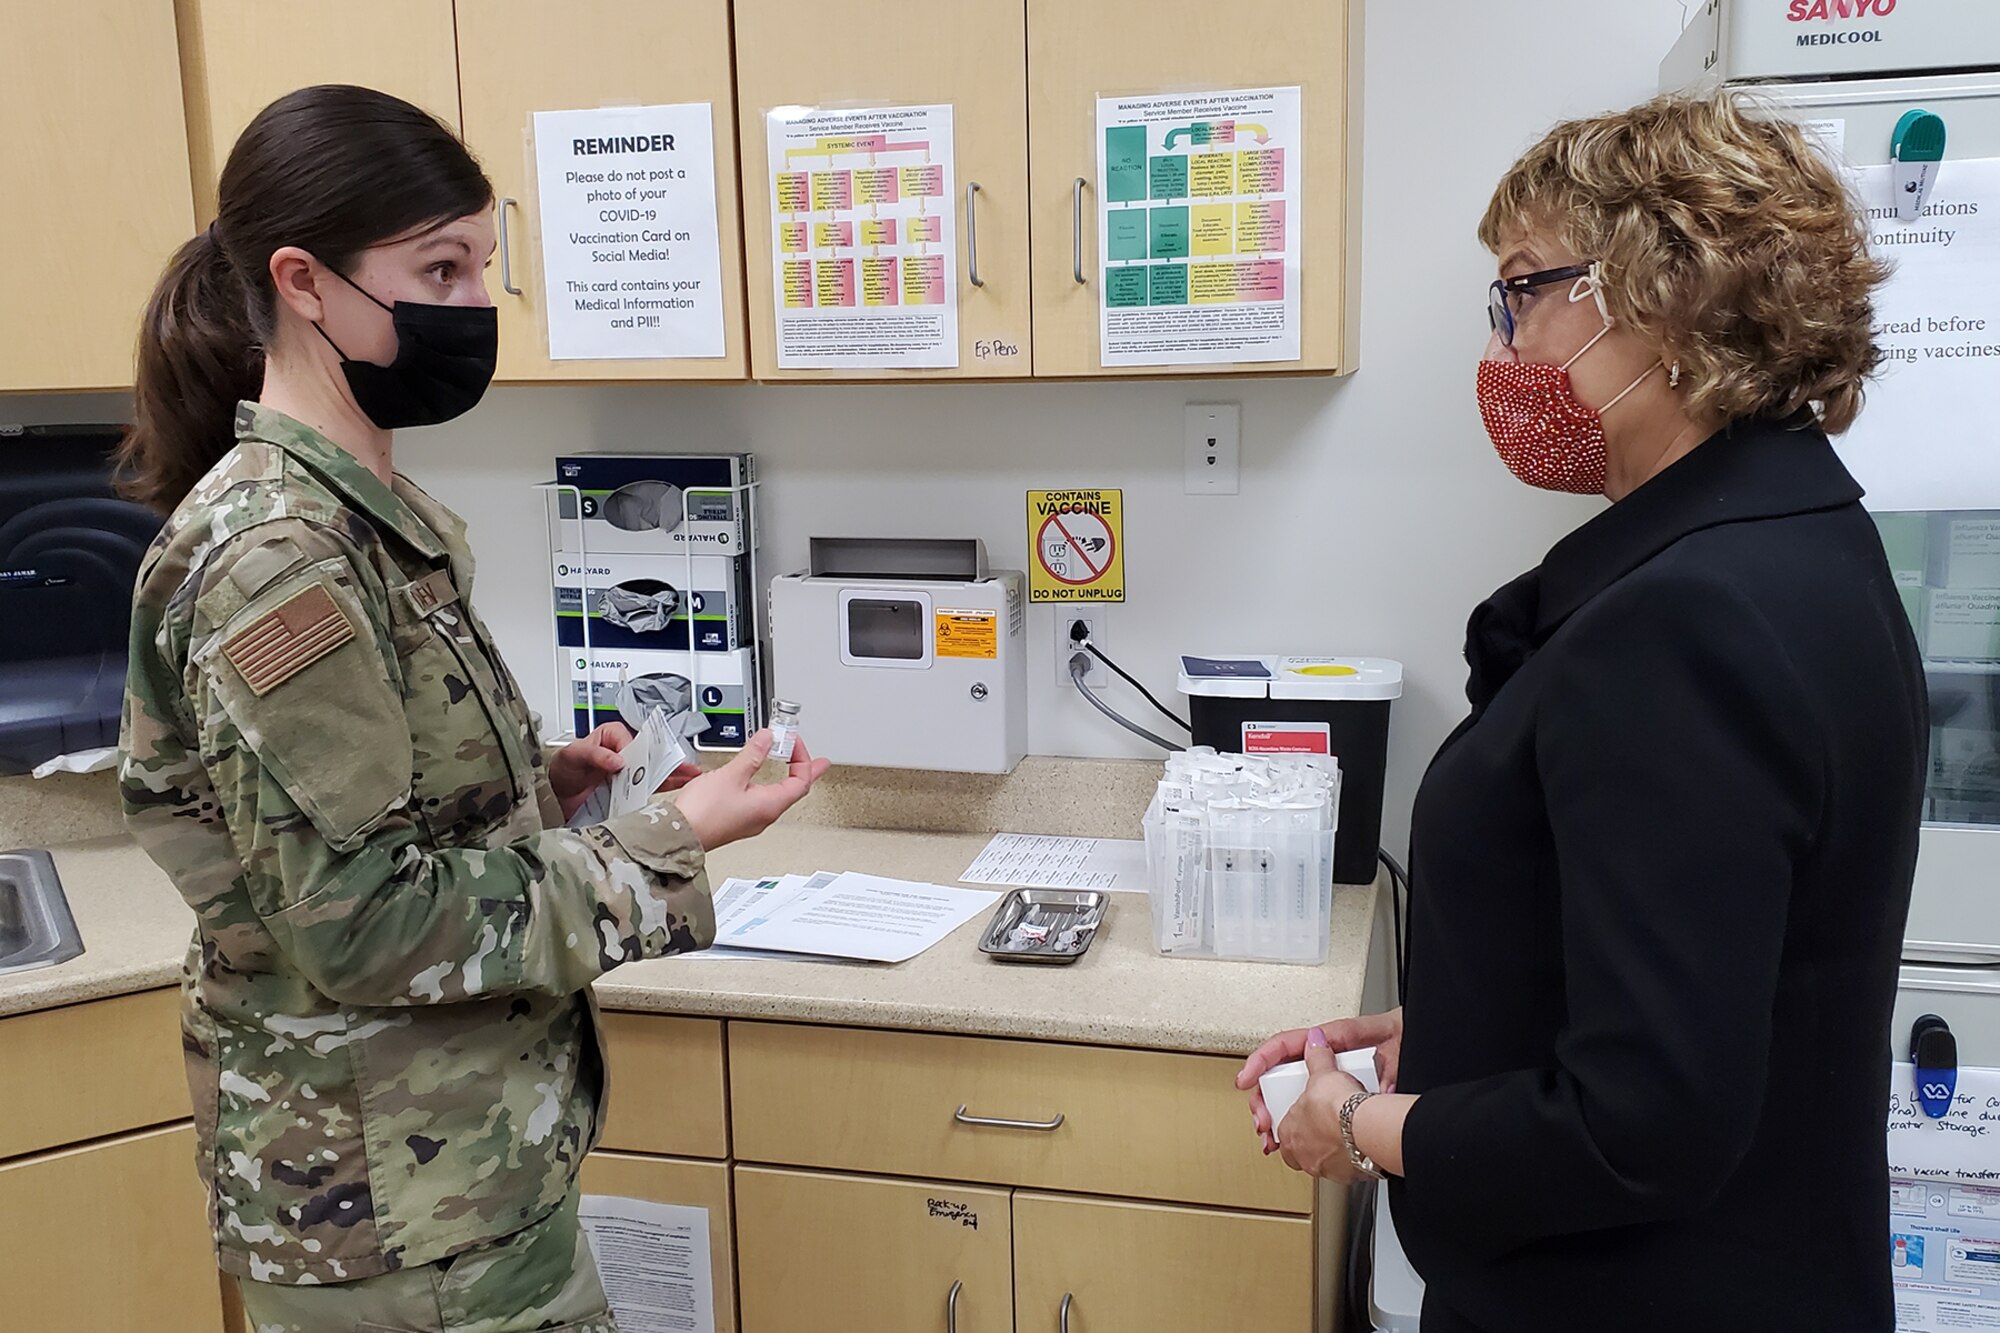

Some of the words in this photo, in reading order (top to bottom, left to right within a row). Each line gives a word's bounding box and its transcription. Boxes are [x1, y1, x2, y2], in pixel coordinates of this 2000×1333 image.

[1796, 30, 1883, 46] MEDICOOL
[1118, 102, 1151, 110] MANAGING
[1183, 98, 1207, 106] EVENTS
[1231, 94, 1274, 103] VACCINATION
[845, 114, 867, 122] EVENTS
[888, 111, 927, 119] VACCINATION
[854, 121, 880, 129] Receives
[881, 120, 904, 128] Vaccine
[573, 134, 675, 155] REMINDER
[857, 140, 875, 148] EVENT
[565, 171, 604, 183] Please
[607, 169, 623, 182] do
[626, 169, 646, 181] not
[649, 168, 674, 182] post
[677, 169, 686, 179] a
[587, 189, 622, 204] photo
[624, 187, 637, 201] of
[639, 189, 667, 202] your
[599, 209, 657, 222] COVID-19
[569, 232, 639, 245] Vaccination
[641, 229, 671, 242] Card
[674, 231, 690, 242] on
[1873, 227, 1956, 247] ontinuity
[591, 249, 625, 263] Social
[628, 248, 670, 261] Media!
[566, 280, 589, 293] This
[591, 280, 618, 292] card
[621, 279, 670, 291] contains
[673, 280, 701, 293] your
[574, 298, 621, 311] Medical
[623, 297, 694, 310] Information
[610, 316, 634, 329] and
[637, 315, 661, 328] PII!!
[1883, 317, 1921, 334] read
[1927, 315, 1986, 332] before
[1924, 341, 2000, 358] vaccines
[1046, 491, 1101, 502] CONTAINS
[584, 501, 592, 514] S
[1036, 501, 1112, 515] VACCINE
[1033, 590, 1049, 599] DO
[1052, 589, 1074, 599] NOT
[1078, 589, 1122, 599] UNPLUG
[708, 690, 717, 703] L
